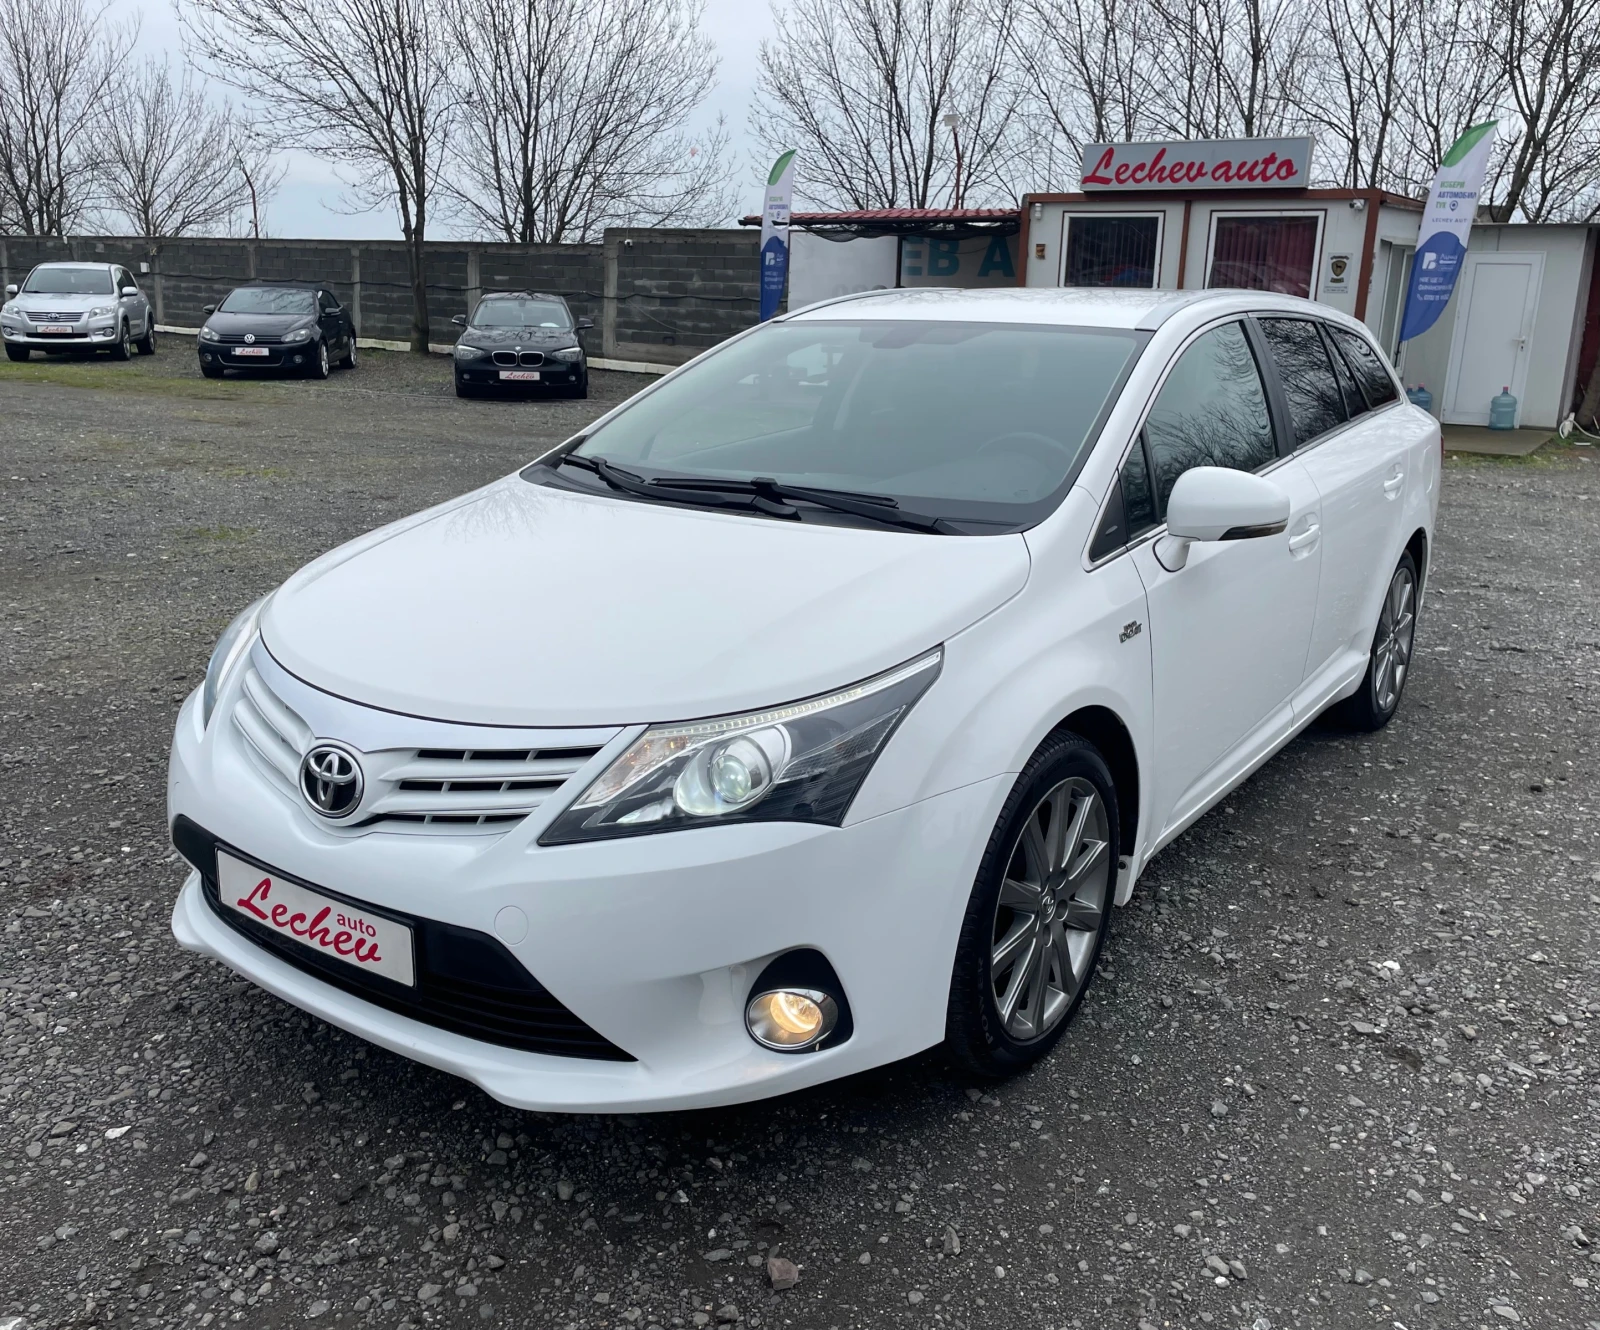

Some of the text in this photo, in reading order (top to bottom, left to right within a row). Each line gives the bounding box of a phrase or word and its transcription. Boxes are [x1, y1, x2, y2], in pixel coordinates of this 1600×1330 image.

[1082, 147, 1298, 185] Lechev auto
[236, 877, 382, 963] Lechev
[336, 913, 377, 938] auto
